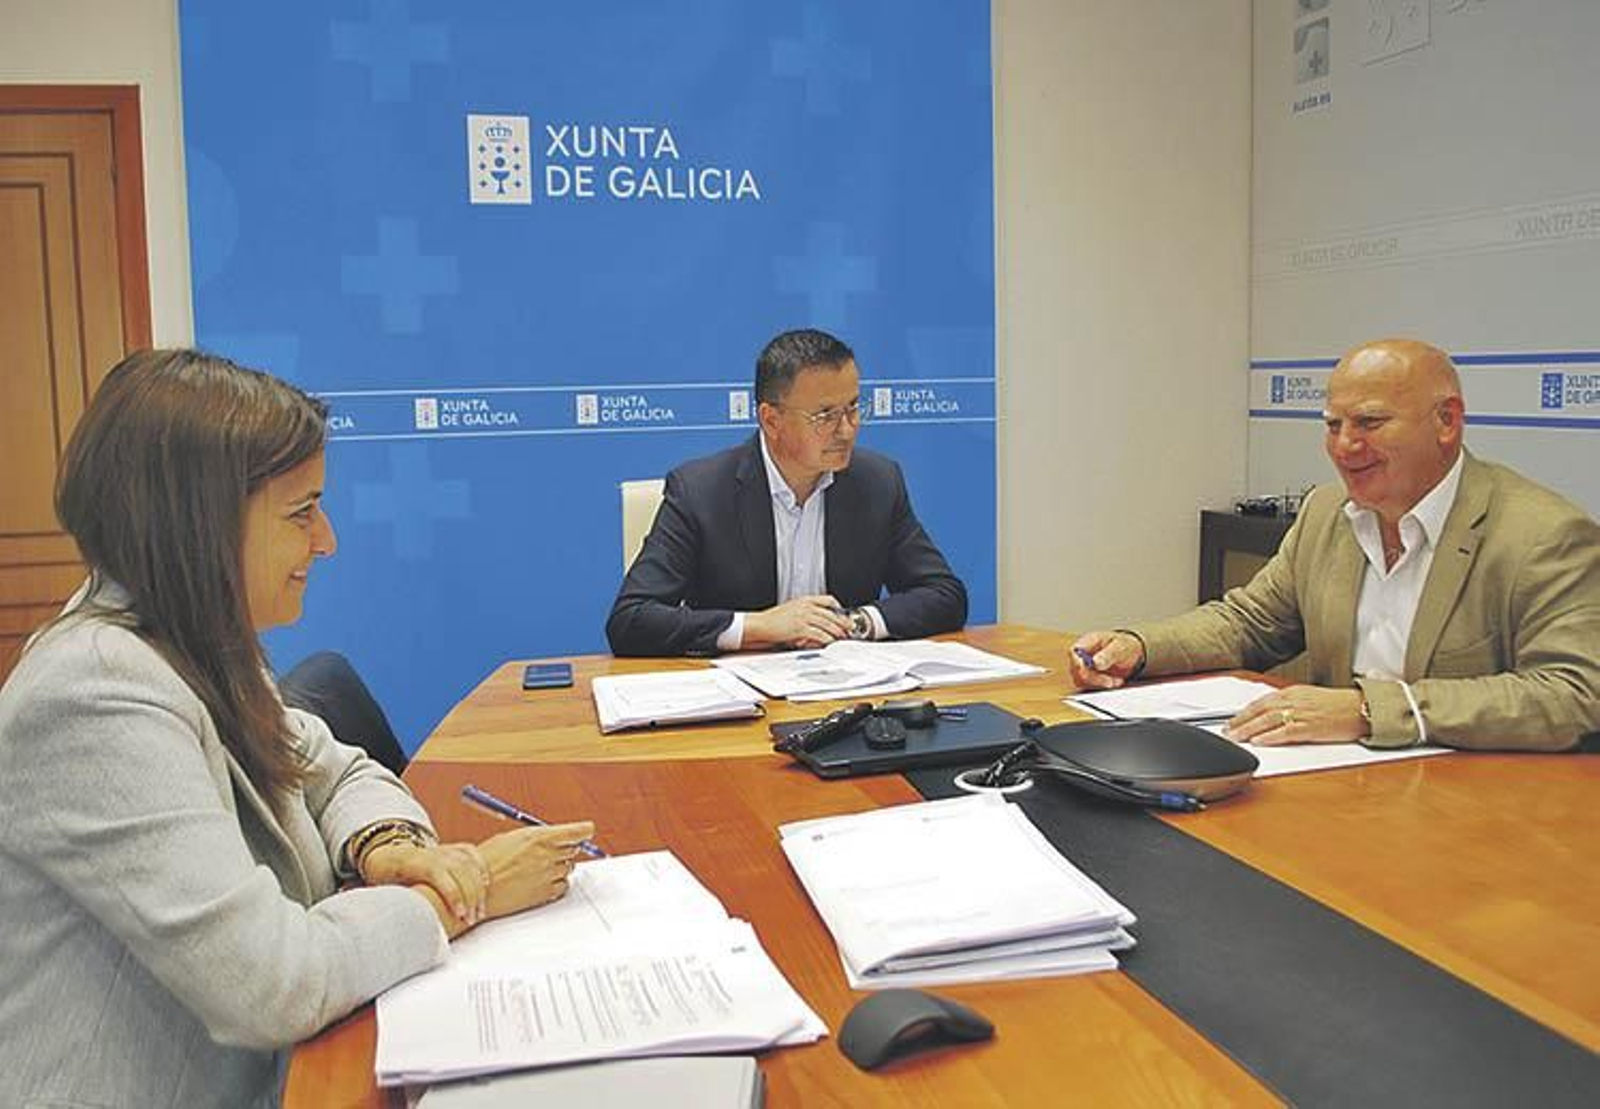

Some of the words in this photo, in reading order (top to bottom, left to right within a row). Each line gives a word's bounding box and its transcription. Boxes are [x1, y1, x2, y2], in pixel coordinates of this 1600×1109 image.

[545, 124, 680, 159] XUNTA
[545, 165, 595, 197] DE
[608, 165, 761, 199] GALICIA
[1566, 374, 1600, 389] XUNT
[894, 390, 936, 401] XUNTA
[441, 399, 489, 412] XUNTA
[601, 396, 648, 409] XUNTA
[894, 402, 909, 413] DE
[913, 401, 960, 413] GALICIA
[441, 413, 460, 426] DE
[462, 412, 519, 425] GALICIA
[601, 409, 619, 421] DE
[622, 408, 675, 421] GALICIA
